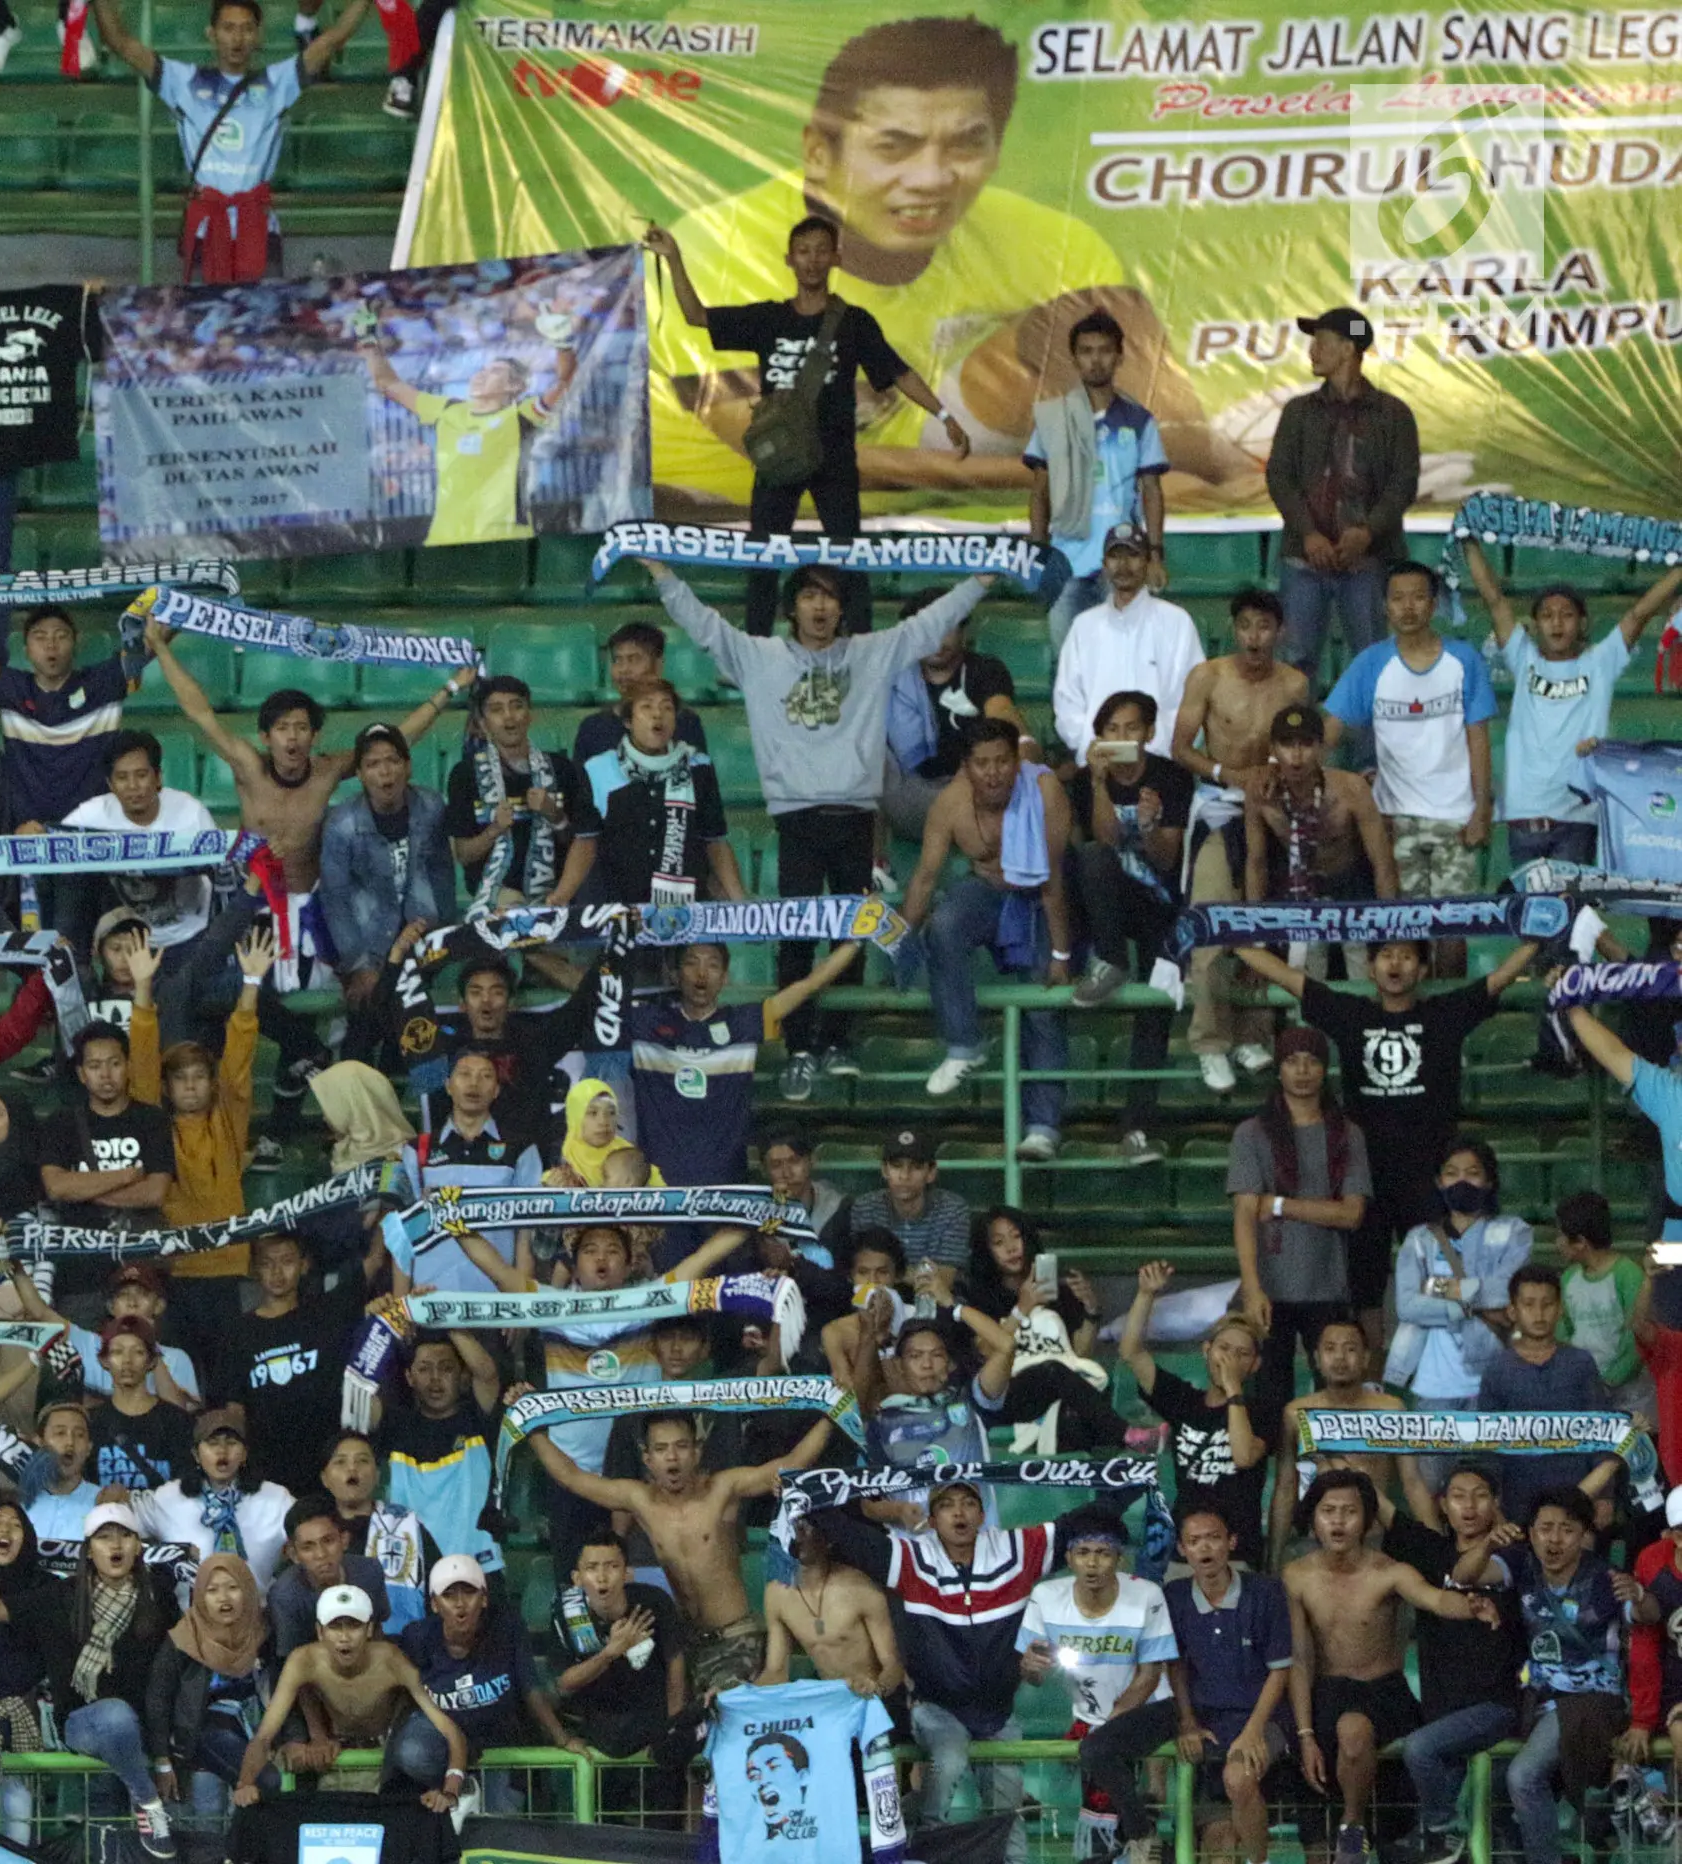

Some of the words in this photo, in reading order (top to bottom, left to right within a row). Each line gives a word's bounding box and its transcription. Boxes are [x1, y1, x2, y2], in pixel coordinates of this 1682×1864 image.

[476, 20, 756, 52] TERIMAKASIH
[1036, 26, 1254, 74] SELAMAT
[1268, 17, 1422, 70] JALAN
[1442, 15, 1568, 61] SANG
[1152, 82, 1354, 119] Persela
[1094, 150, 1454, 202] CHOIRUL
[1359, 252, 1599, 303] KARLA
[818, 535, 1045, 580] LAMONGAN
[156, 590, 289, 648] PERSELA
[704, 897, 846, 939] LAMONGAN
[1380, 1040, 1402, 1074] 9
[423, 1287, 679, 1327] PERSELA
[1316, 1413, 1460, 1443] PERSELA
[1476, 1414, 1629, 1446] LAMONGAN
[796, 1467, 912, 1508] Pride
[1019, 1459, 1097, 1481] Our
[472, 1673, 512, 1704] DAYS
